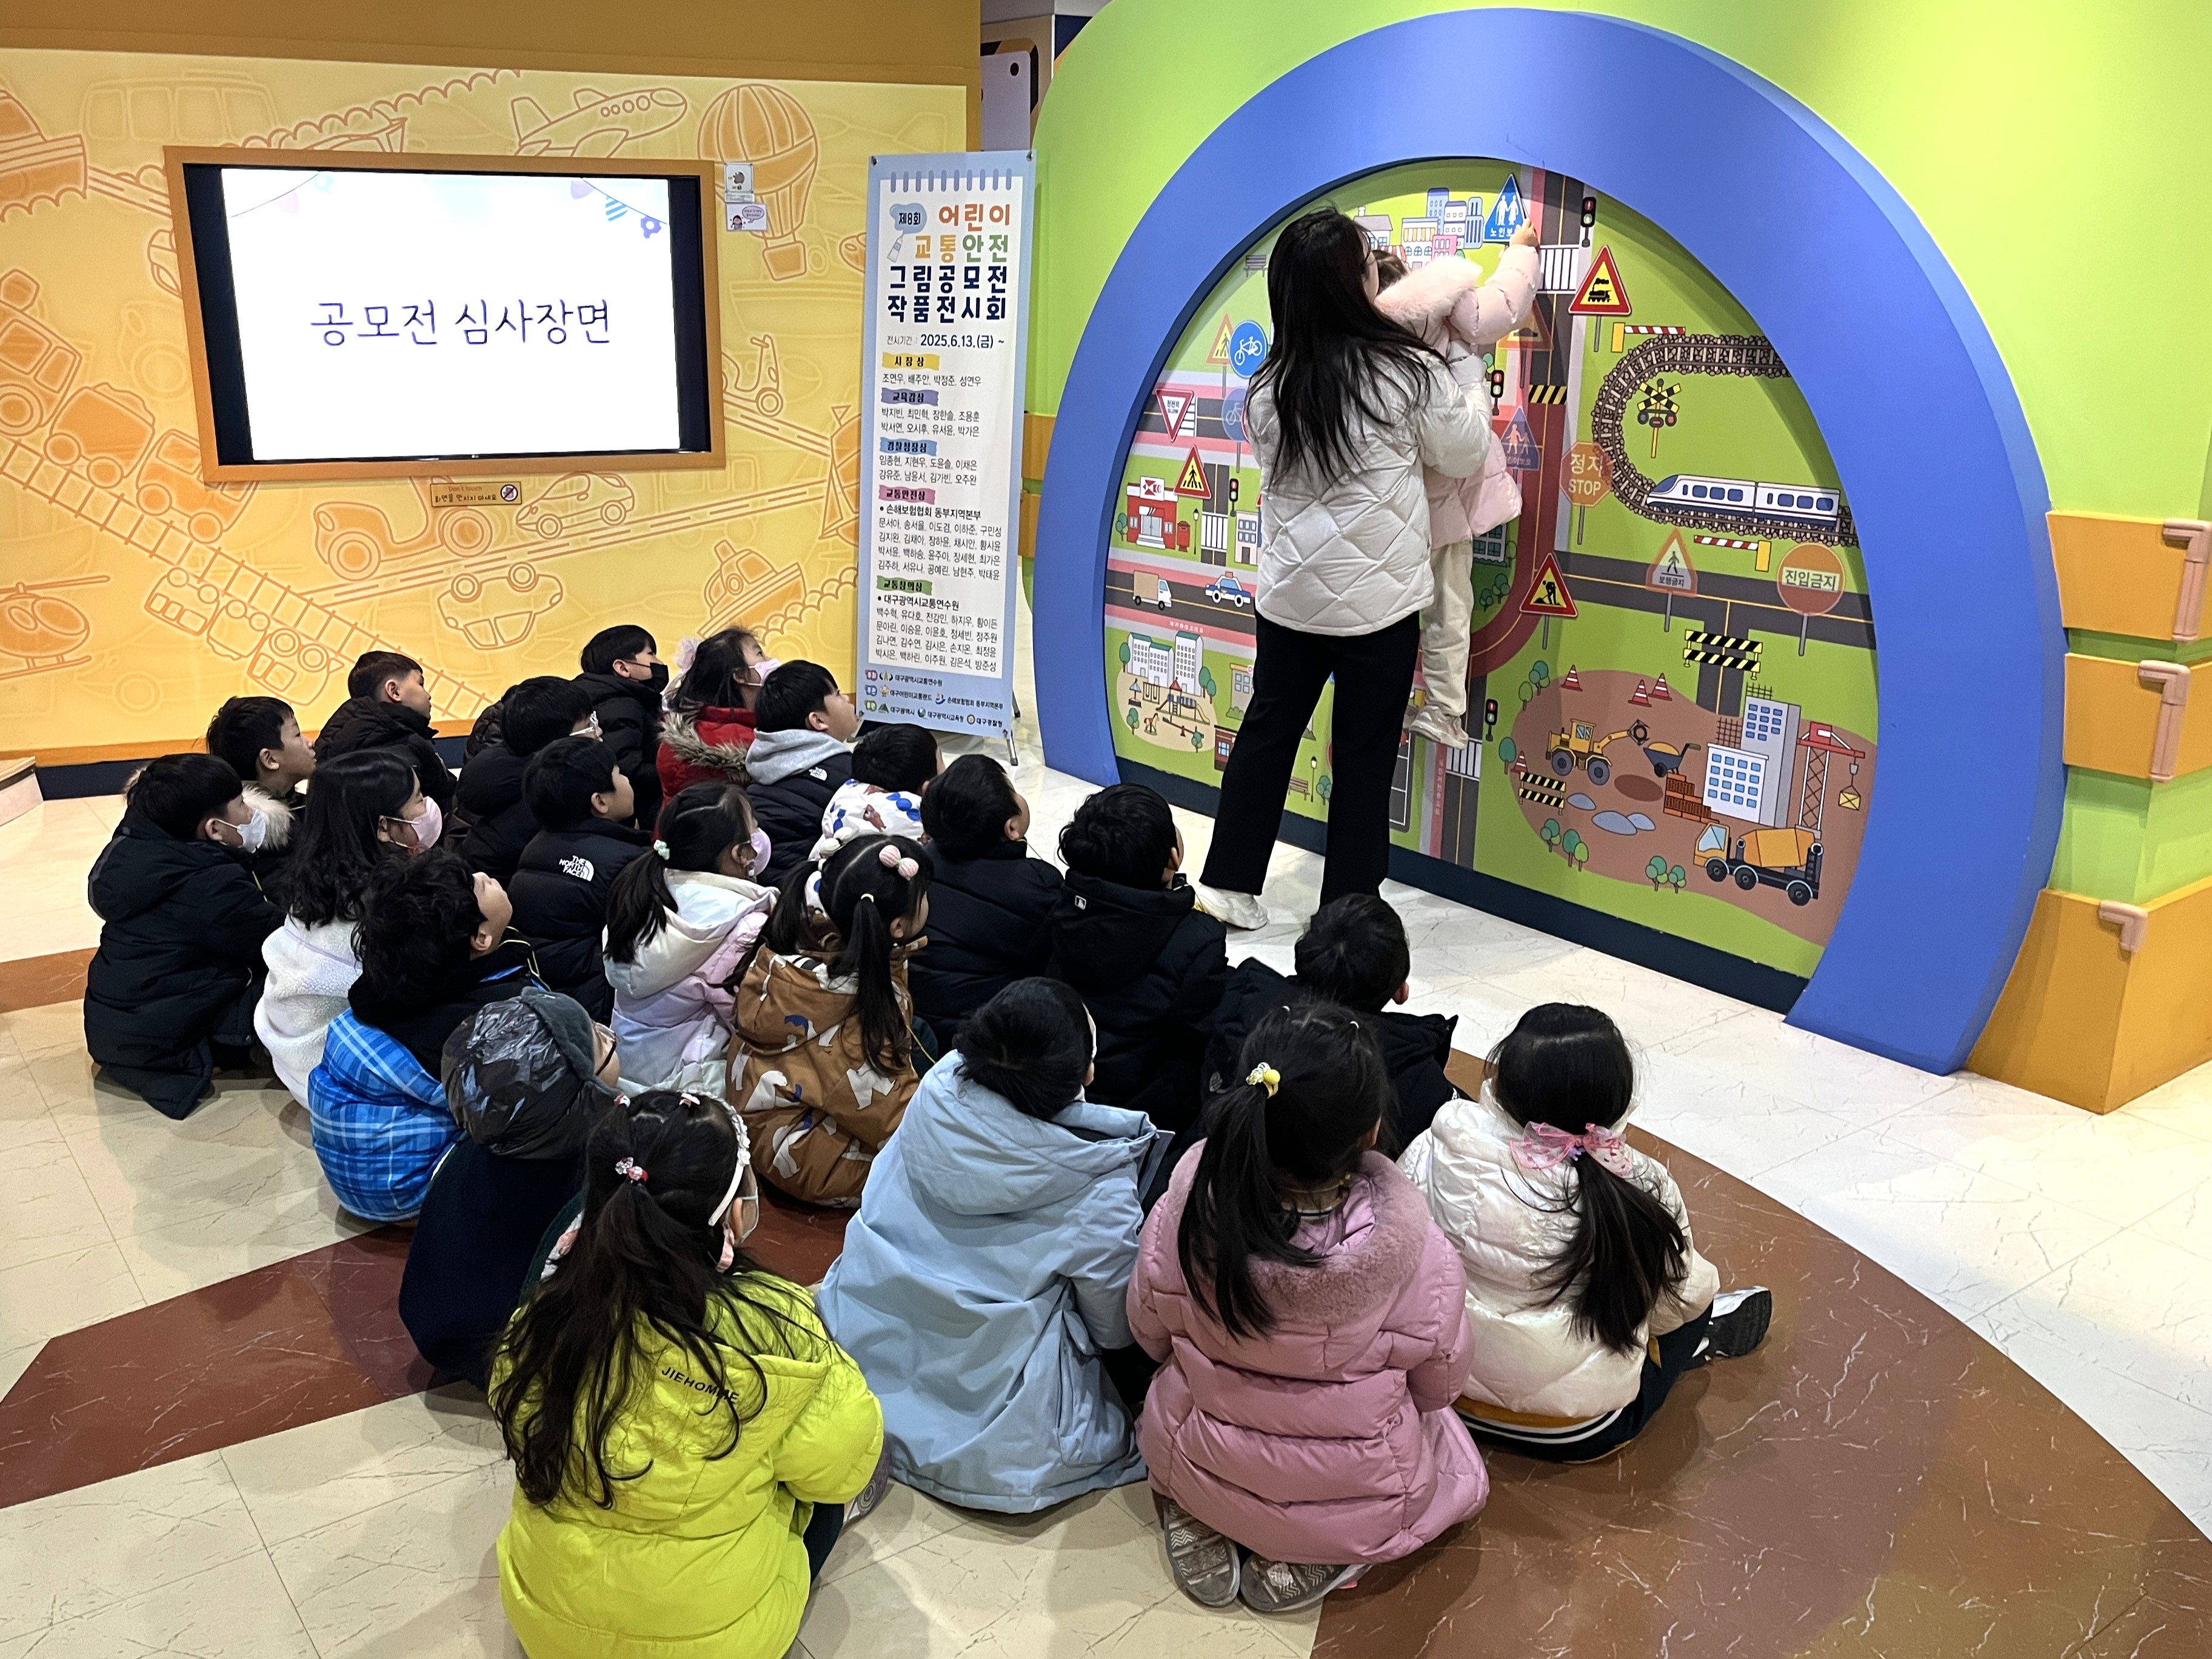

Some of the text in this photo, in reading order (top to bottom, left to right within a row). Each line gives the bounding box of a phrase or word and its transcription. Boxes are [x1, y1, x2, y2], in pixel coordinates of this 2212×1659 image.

[899, 212, 921, 225] 제8회
[938, 204, 1010, 232] 어린이
[1490, 227, 1513, 238] 노인보
[915, 235, 1008, 263] 교통안전
[890, 265, 1007, 293] 그림공모전
[887, 295, 1006, 324] 작품전시회
[310, 298, 610, 347] 공모전 심사장면
[887, 336, 912, 345] 전시기간
[921, 334, 994, 349] 2025.6.13.(금)
[960, 376, 981, 387] 성연우
[958, 426, 979, 437] 박가은
[1571, 454, 1602, 477] 정지
[1569, 479, 1601, 496] STOP
[887, 504, 981, 521] 손해보험협회 동부지역본부
[1659, 576, 1684, 587] 보행금지
[1785, 570, 1837, 591] 진입금지
[884, 595, 959, 611] 대구광역시교통연수원
[559, 858, 583, 872] NORTH
[572, 855, 586, 866] THE
[563, 866, 581, 878] FACE
